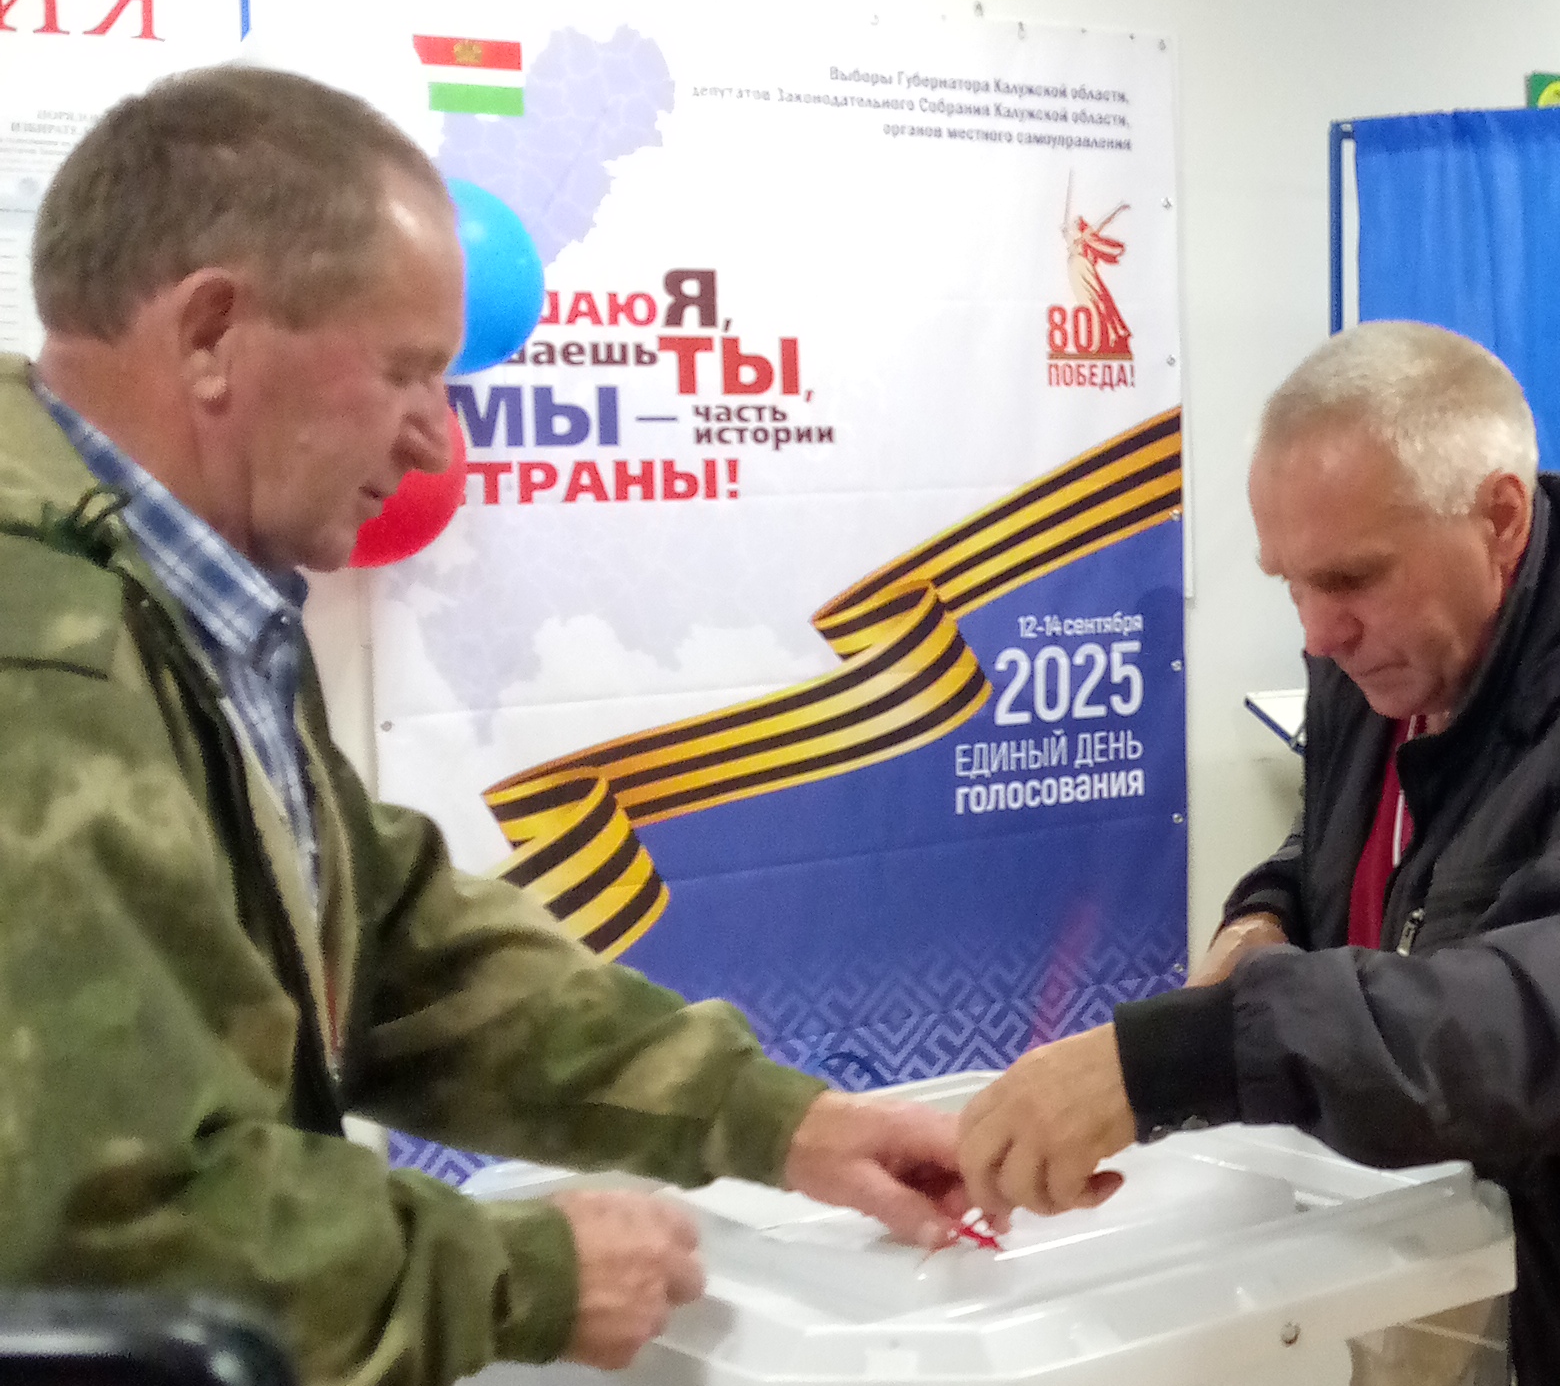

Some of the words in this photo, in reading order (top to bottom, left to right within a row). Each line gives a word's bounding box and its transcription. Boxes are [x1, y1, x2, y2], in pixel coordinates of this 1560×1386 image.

[777, 88, 915, 112] Законодательного
[918, 97, 990, 118] Собрания
[993, 102, 1068, 124] Калужской
[829, 66, 894, 87] Выборы
[897, 71, 990, 94] Губернатора
[993, 76, 1068, 100] Калужской
[883, 123, 942, 139] органов
[947, 127, 1013, 144] местного
[663, 268, 731, 332] Я,
[1048, 305, 1093, 354] 80
[658, 336, 813, 402] ТЫ,
[1048, 363, 1135, 390] ПОБЕДА!
[446, 384, 620, 447] МЫ
[693, 404, 787, 424] часть
[693, 425, 834, 451] истории
[463, 459, 740, 505] ТРАНЫ!
[1017, 614, 1062, 638] 12-14
[1063, 611, 1144, 636] сентября
[994, 640, 1144, 725] 2025
[955, 728, 1068, 779] ЕДИНЫЙ
[1074, 728, 1144, 768] ДЕНЬ
